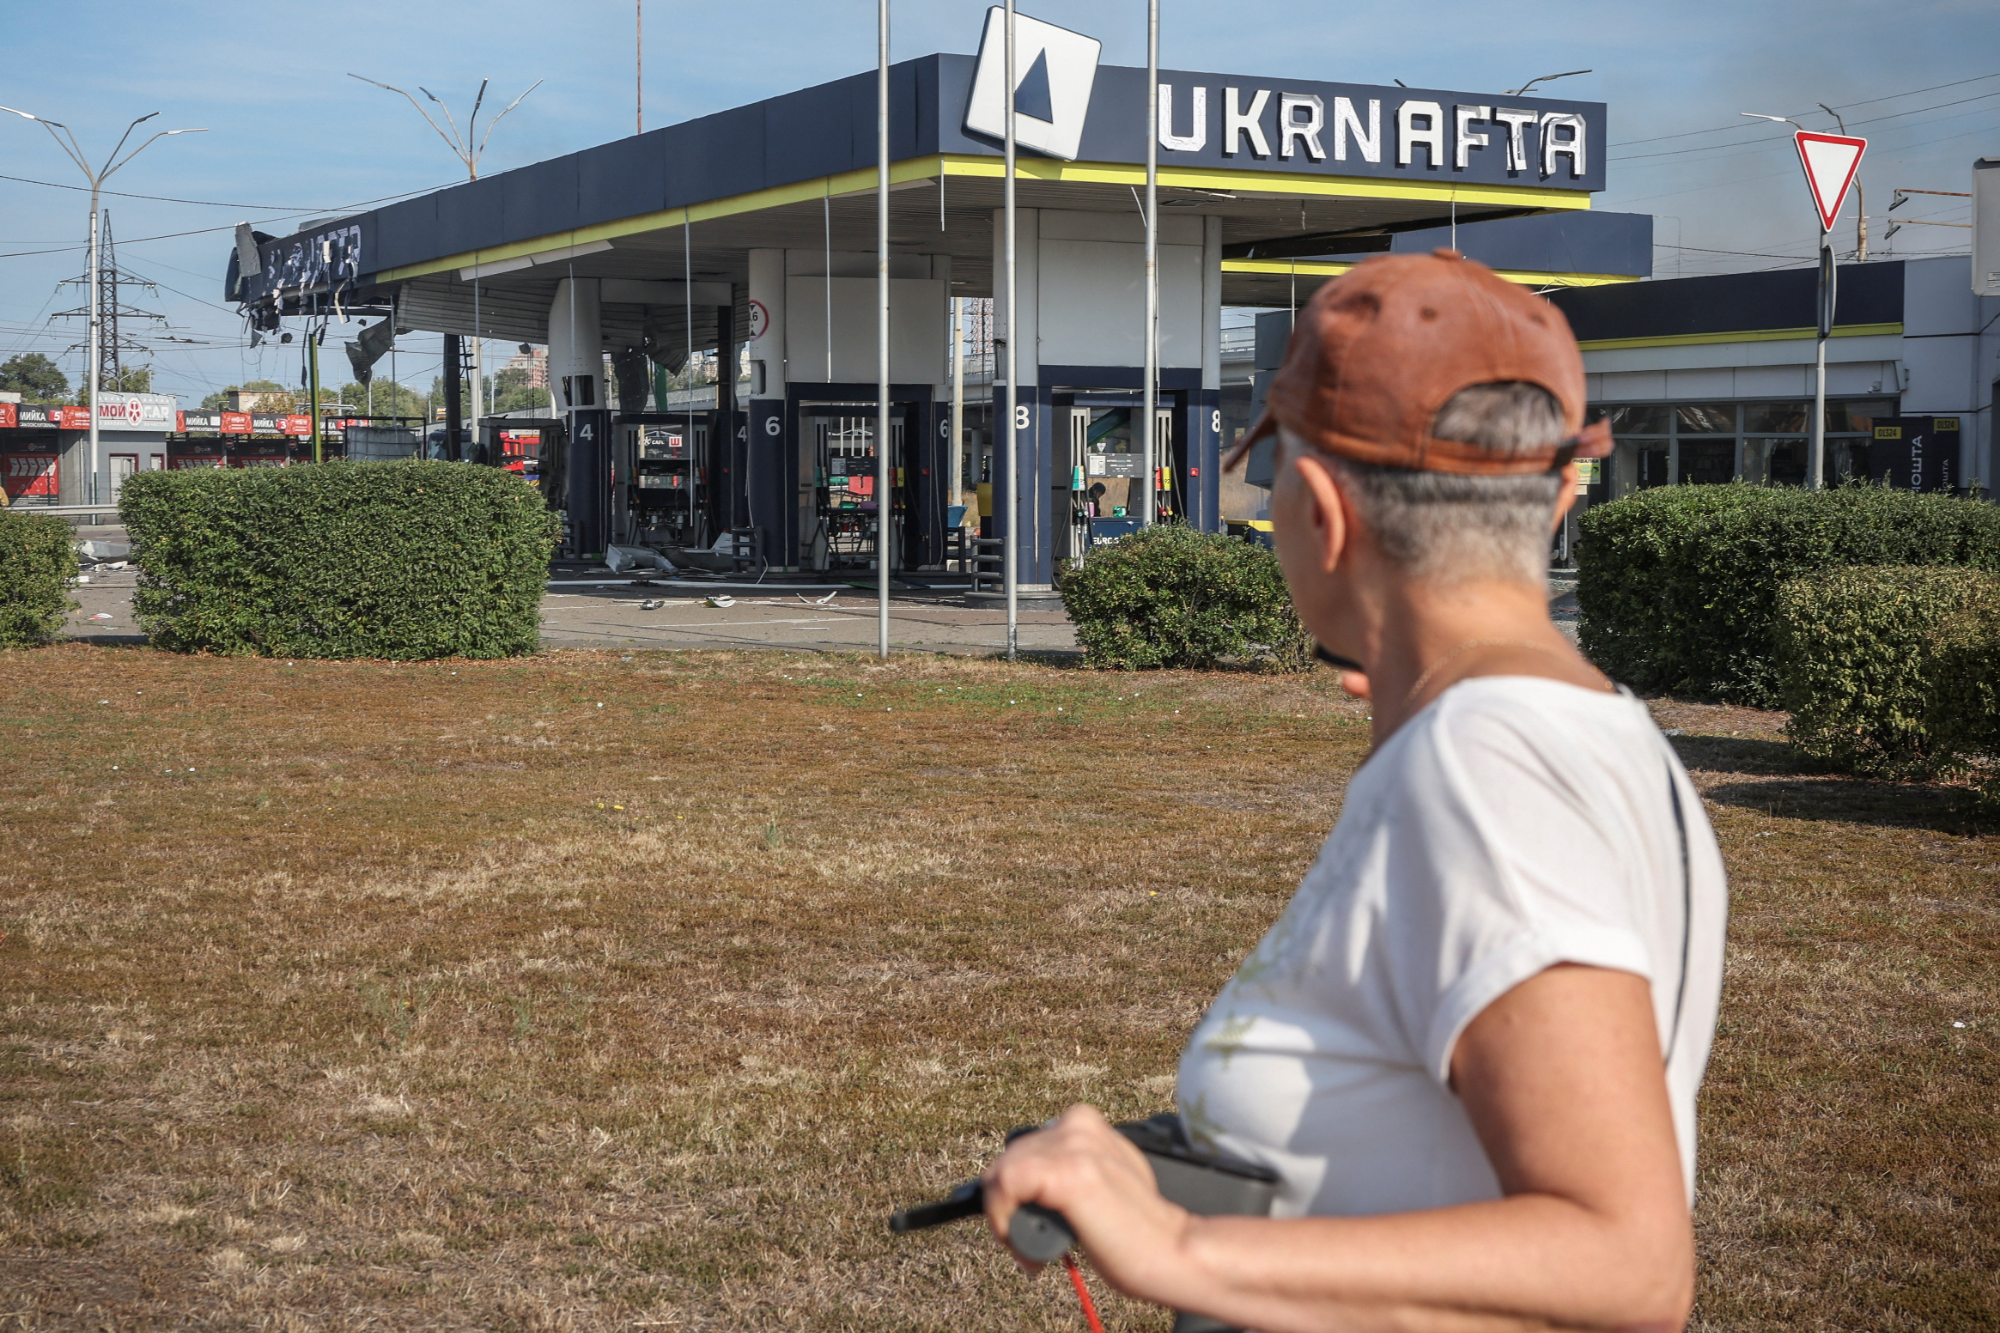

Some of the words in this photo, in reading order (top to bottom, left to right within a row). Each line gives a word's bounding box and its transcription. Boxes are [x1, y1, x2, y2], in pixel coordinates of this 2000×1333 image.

[1158, 84, 1586, 177] UKRNAFTA
[19, 410, 46, 421] МИЙКА
[54, 412, 60, 421] 5
[100, 403, 126, 417] МОЙ
[1016, 406, 1030, 429] 8
[186, 416, 208, 425] МИЙКА
[253, 418, 274, 428] МИЙКА
[281, 420, 287, 429] 3
[766, 416, 780, 436] 6
[940, 419, 948, 438] 6
[1212, 409, 1220, 432] 8
[1937, 421, 1954, 429] 01324
[580, 424, 593, 440] 4
[737, 426, 747, 442] 4
[1878, 429, 1897, 437] 01324
